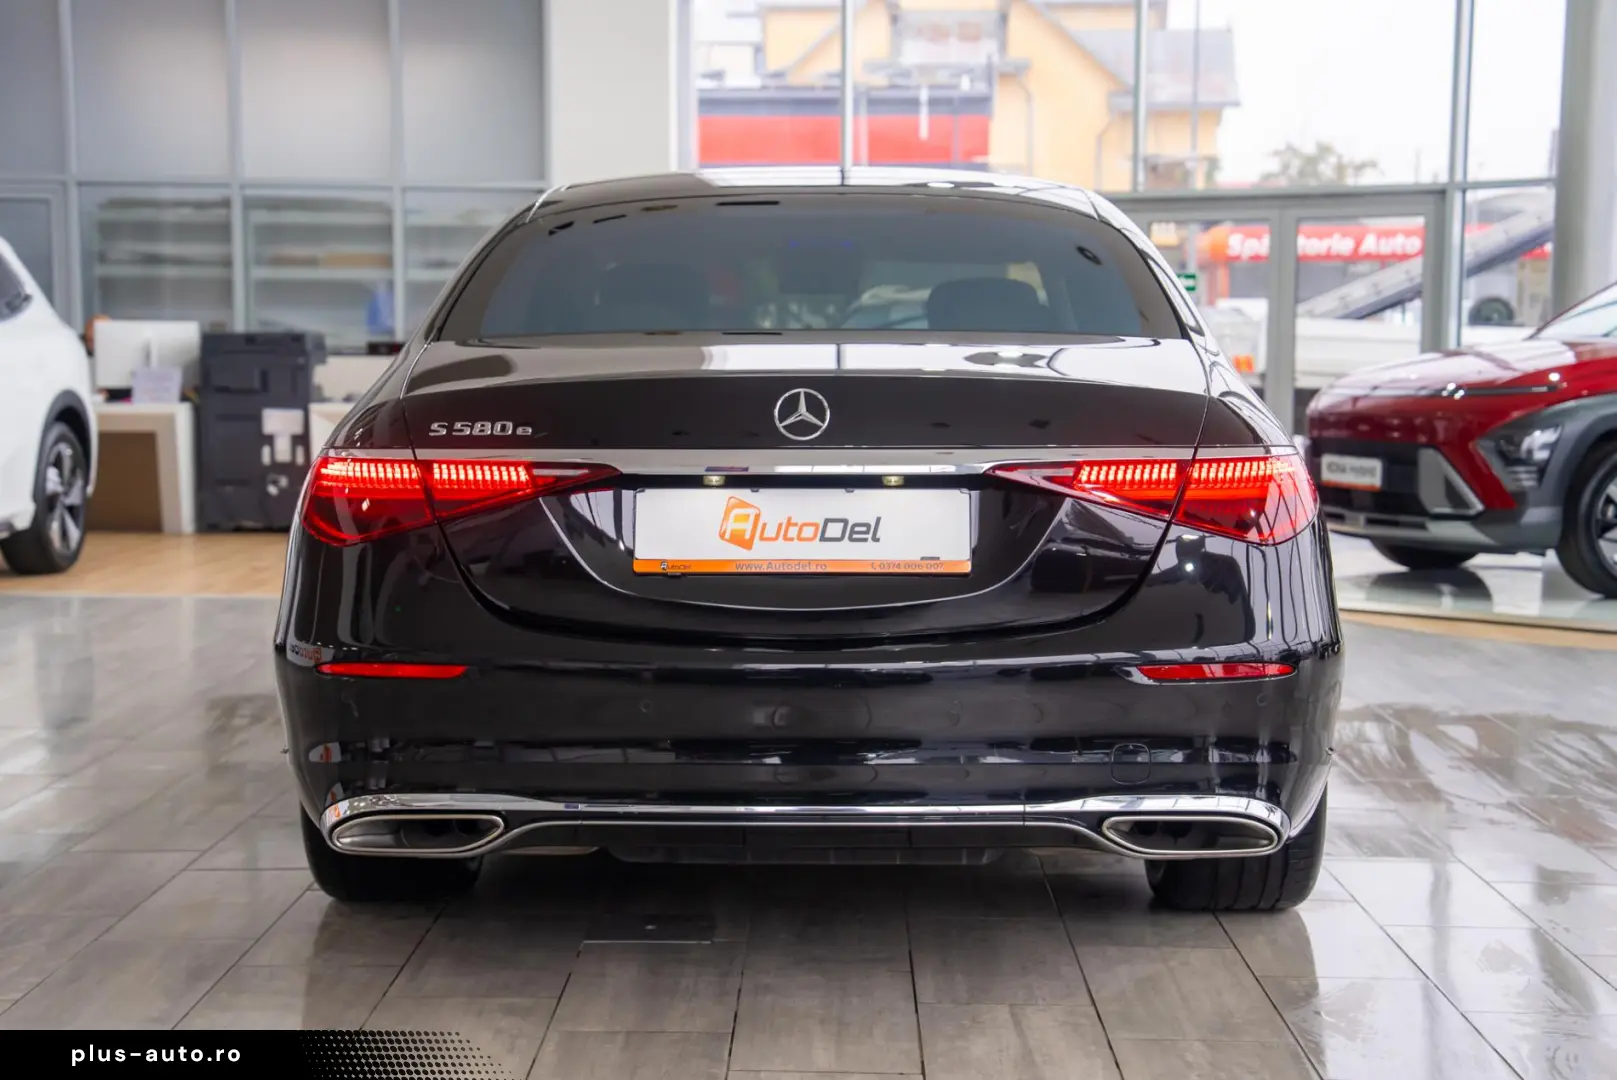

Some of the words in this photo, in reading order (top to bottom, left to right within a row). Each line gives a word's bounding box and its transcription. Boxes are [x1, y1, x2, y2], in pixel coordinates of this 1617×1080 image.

[1359, 232, 1421, 256] Auto
[428, 421, 448, 436] S
[719, 497, 882, 550] AutoDel
[735, 561, 828, 572] www.Autodel.ro
